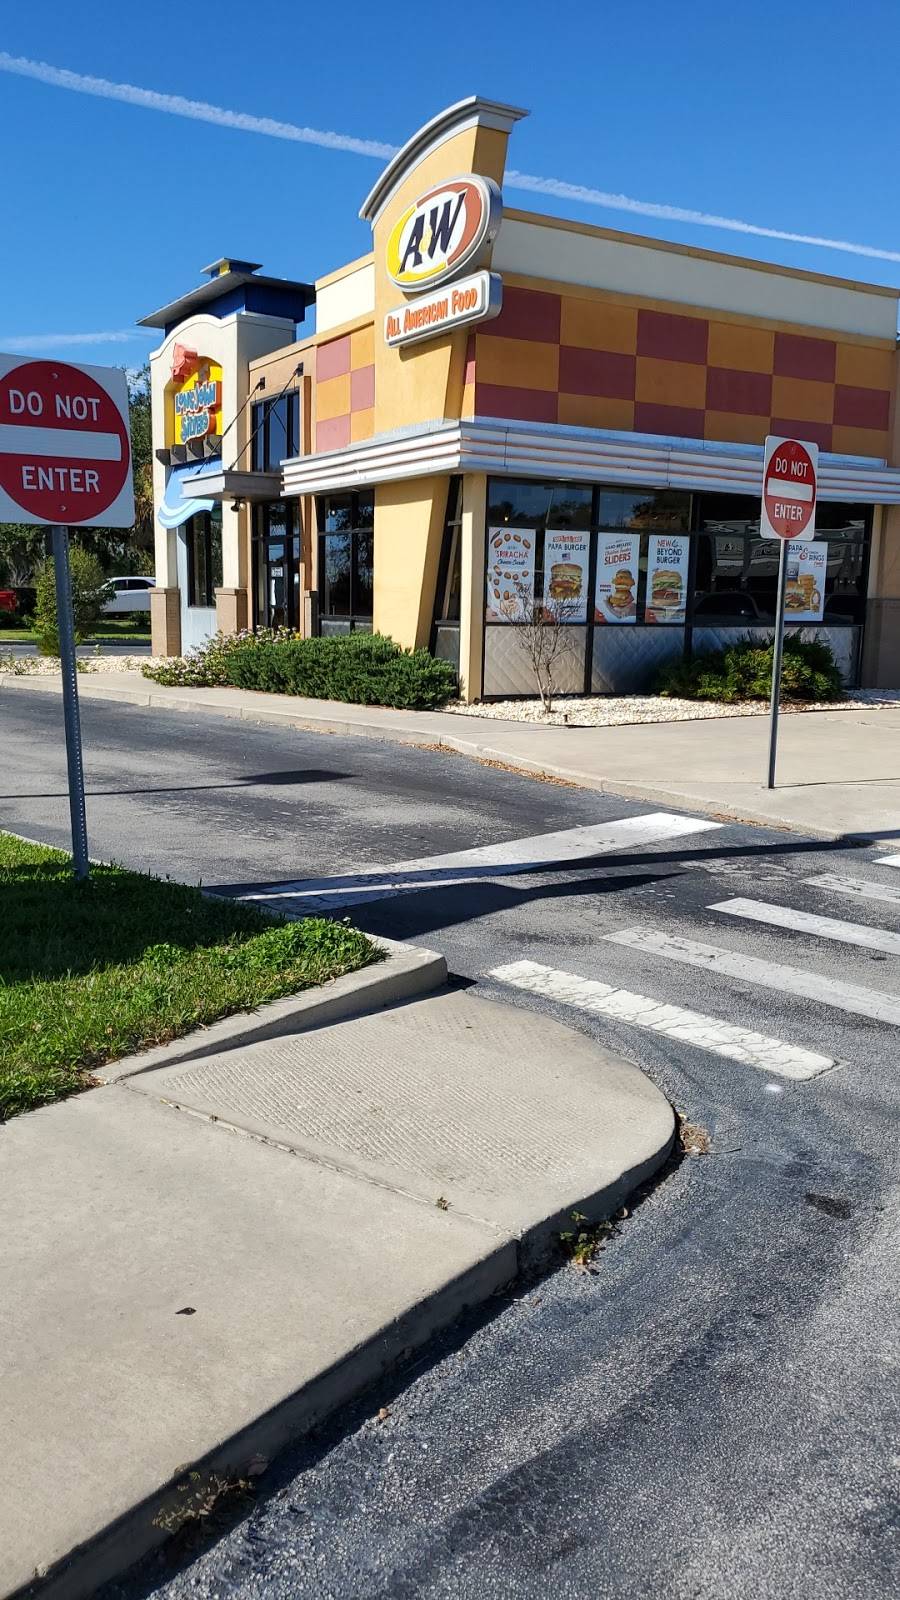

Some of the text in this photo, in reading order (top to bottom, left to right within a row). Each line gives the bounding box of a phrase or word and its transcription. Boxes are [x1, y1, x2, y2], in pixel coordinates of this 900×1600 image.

[9, 389, 100, 421] DO NOT
[775, 458, 809, 478] DO NOT
[22, 466, 100, 493] ENTER
[774, 503, 803, 521] ENTER
[547, 543, 587, 551] PAPA BURGER
[656, 539, 672, 547] NEW
[495, 550, 529, 559] SRIRACHA
[656, 547, 683, 556] BEYOND
[604, 552, 631, 565] SLIDERS
[656, 556, 681, 564] BURGER
